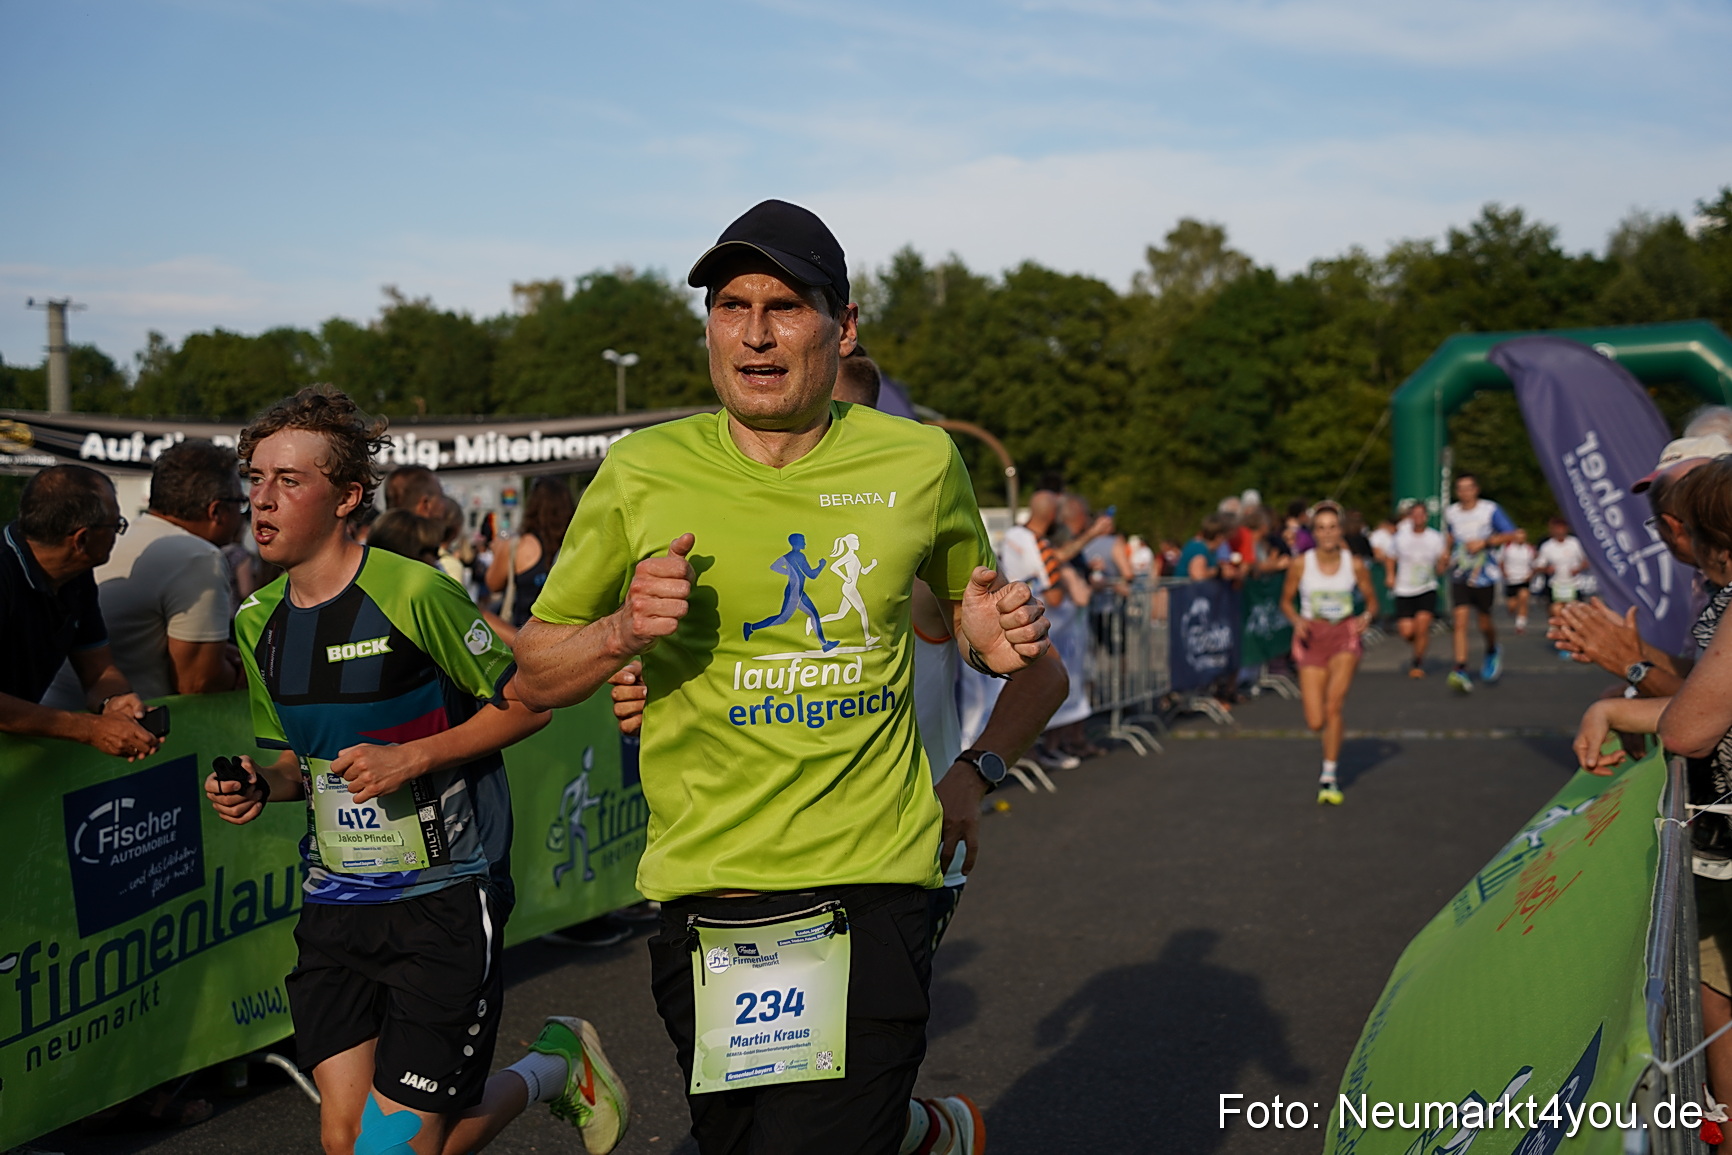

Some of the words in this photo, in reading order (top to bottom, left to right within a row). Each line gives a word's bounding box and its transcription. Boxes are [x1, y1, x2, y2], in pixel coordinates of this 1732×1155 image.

[79, 430, 146, 462] Auf
[819, 492, 884, 507] BERATA
[327, 637, 391, 662] BOCK
[733, 655, 863, 694] laufend
[729, 685, 897, 729] erfolgreich
[98, 806, 182, 854] Fischer
[338, 808, 380, 829] 412
[110, 830, 177, 866] AUTOMOBILE
[338, 833, 362, 843] Jakob
[364, 833, 396, 843] Pfindel
[426, 823, 440, 858] HILTL
[732, 952, 778, 966] Firmenlauf
[752, 960, 780, 968] neumarkt
[232, 986, 287, 1026] www.
[735, 987, 805, 1026] 234
[26, 980, 160, 1072] neumarkt
[729, 1031, 771, 1049] Martin
[773, 1028, 811, 1043] Kraus
[400, 1071, 438, 1093] JAKO
